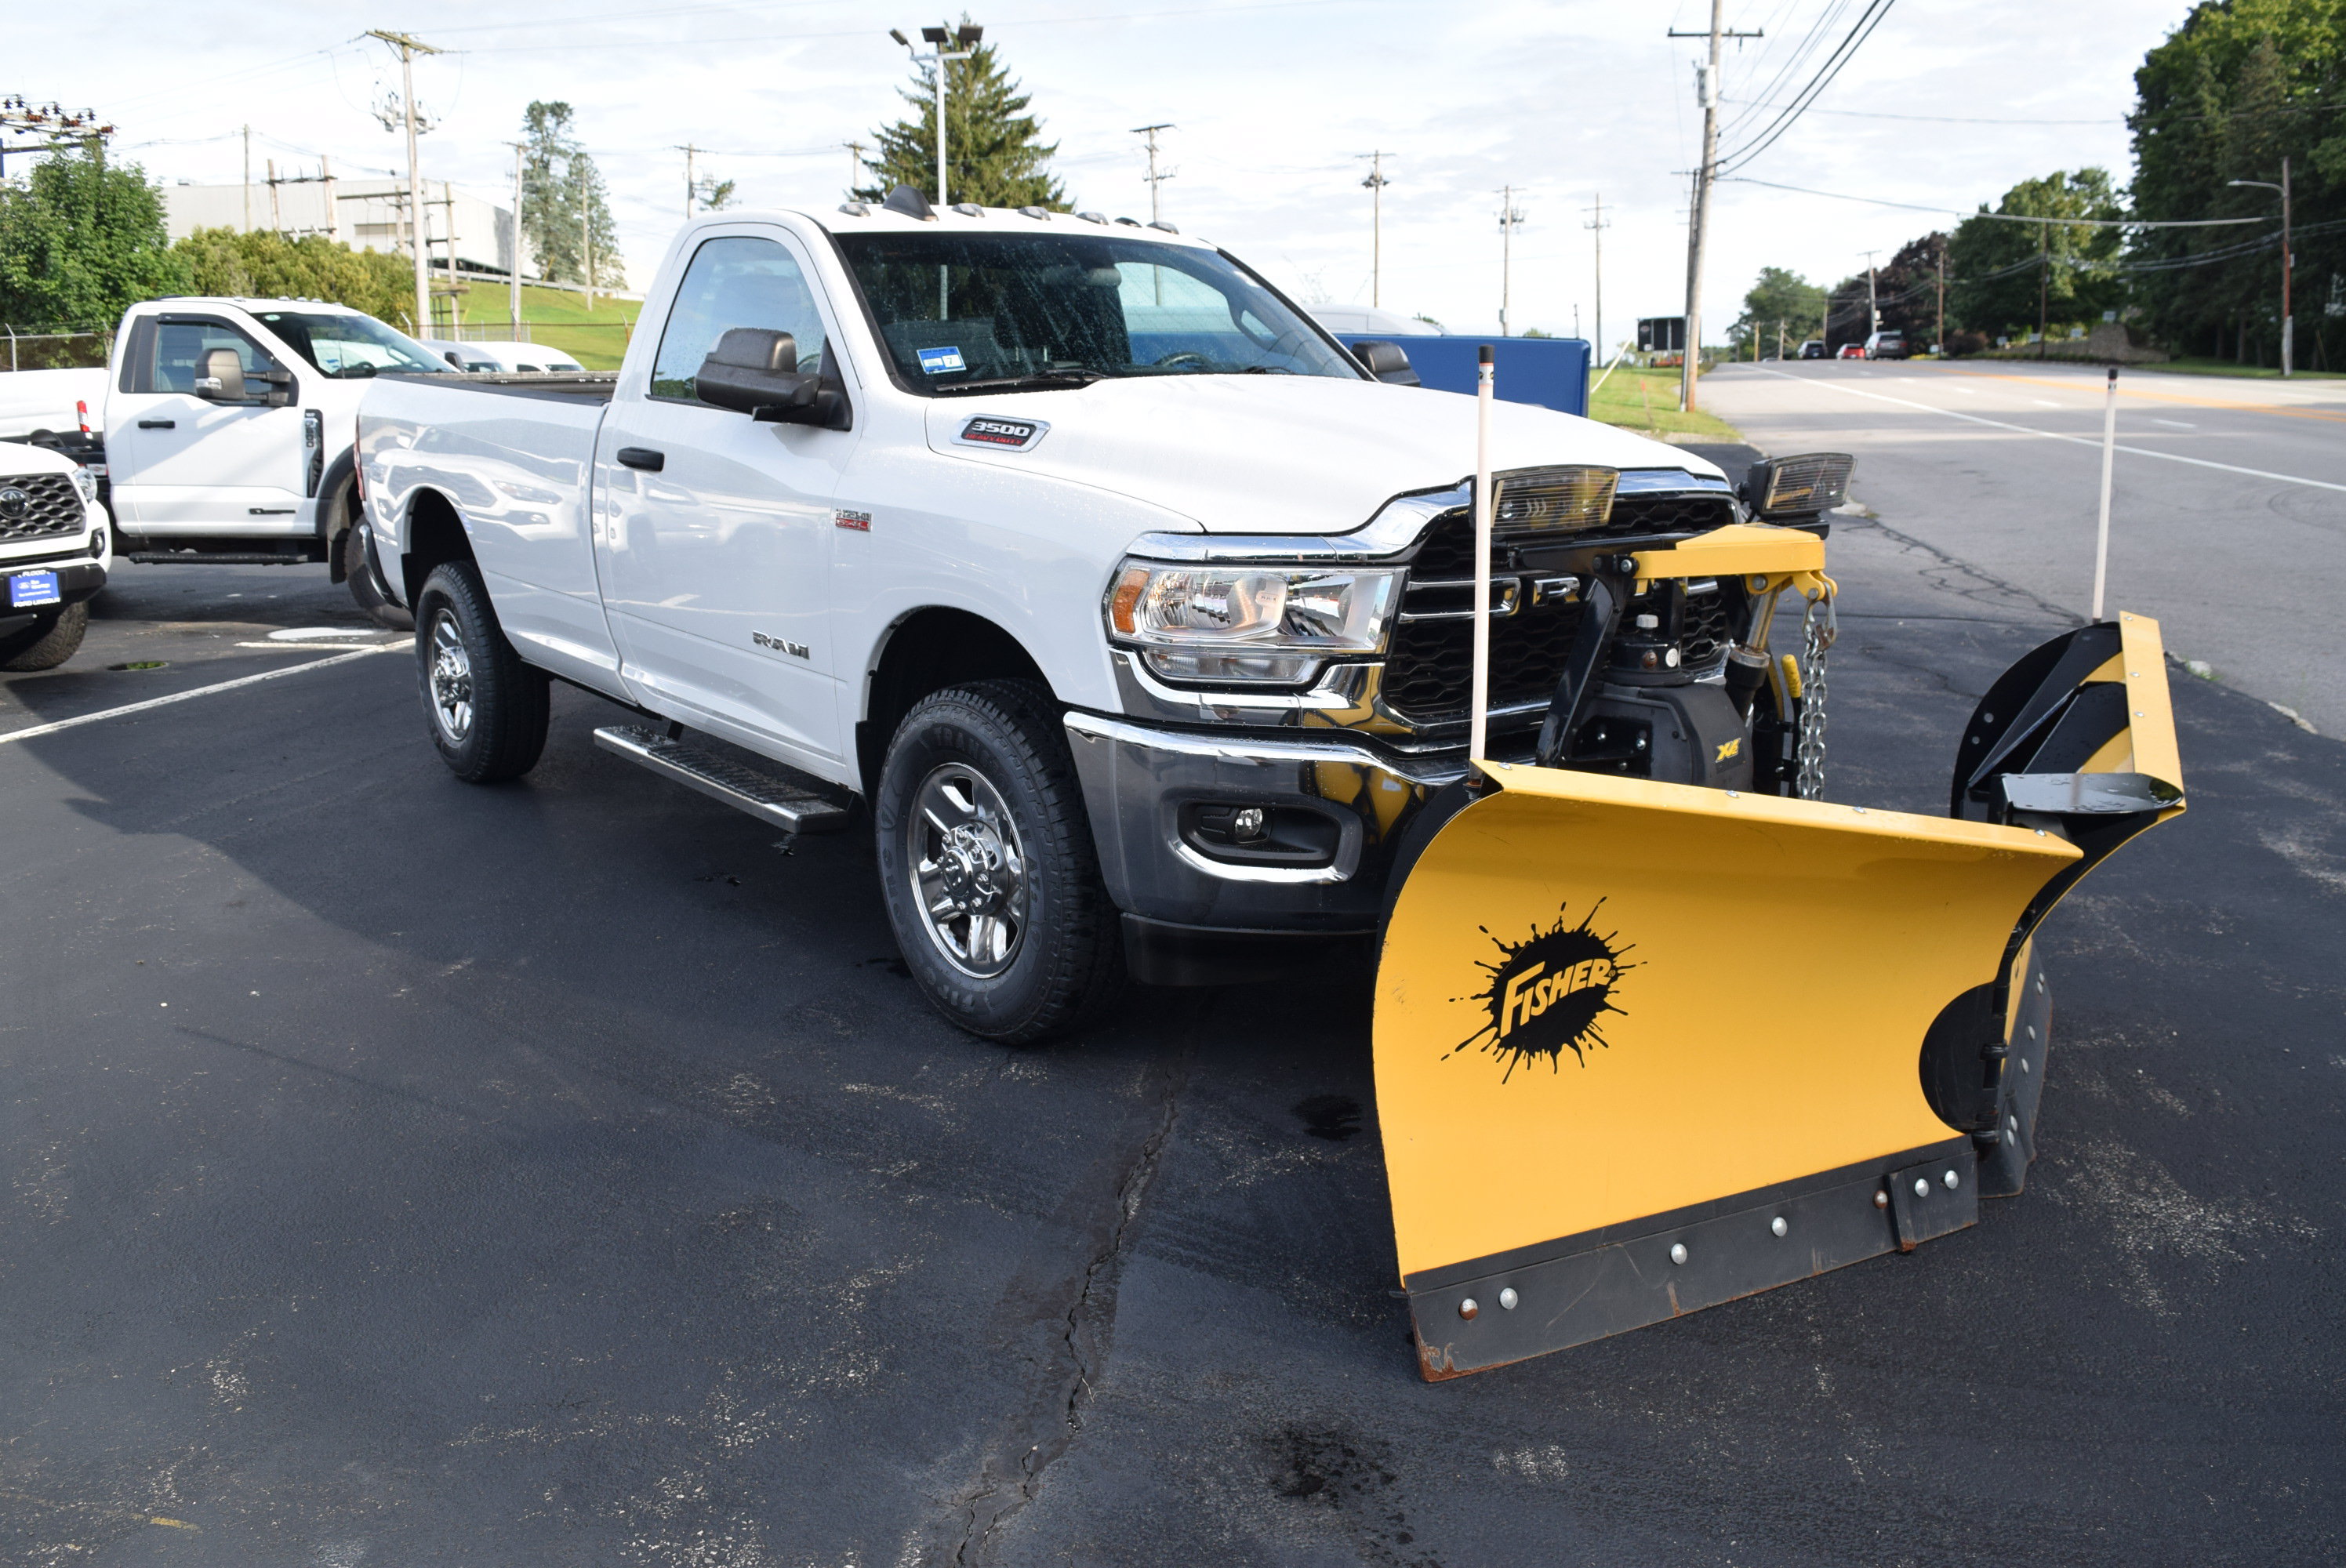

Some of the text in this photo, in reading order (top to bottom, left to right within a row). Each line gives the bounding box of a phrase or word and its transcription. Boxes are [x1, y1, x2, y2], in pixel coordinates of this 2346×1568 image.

[964, 433, 994, 441] HEAVY
[971, 421, 1030, 437] 3500
[752, 630, 810, 660] RAM
[1499, 957, 1612, 1039] FISHER
